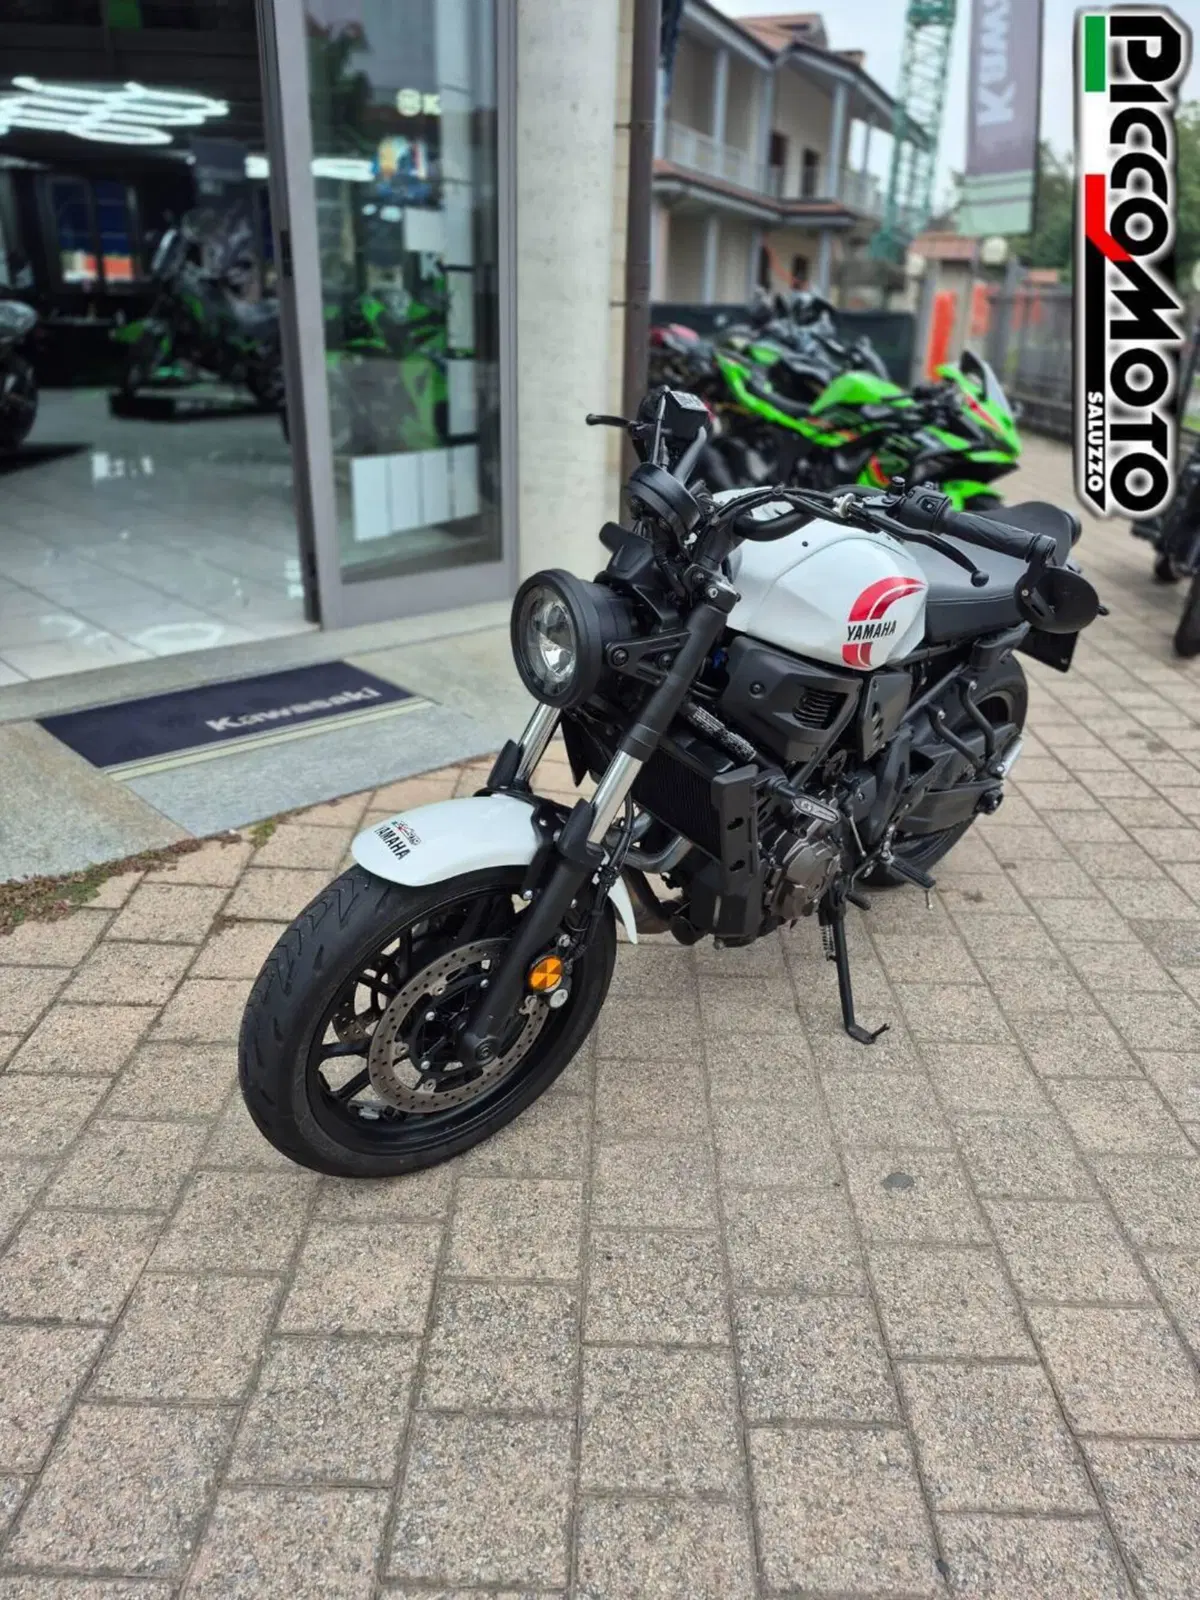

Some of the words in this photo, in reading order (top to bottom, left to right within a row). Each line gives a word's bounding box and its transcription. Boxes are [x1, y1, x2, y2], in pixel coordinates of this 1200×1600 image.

[847, 619, 897, 641] YAMAHA
[204, 686, 382, 732] Kawasaki
[373, 826, 410, 860] YAMAHA
